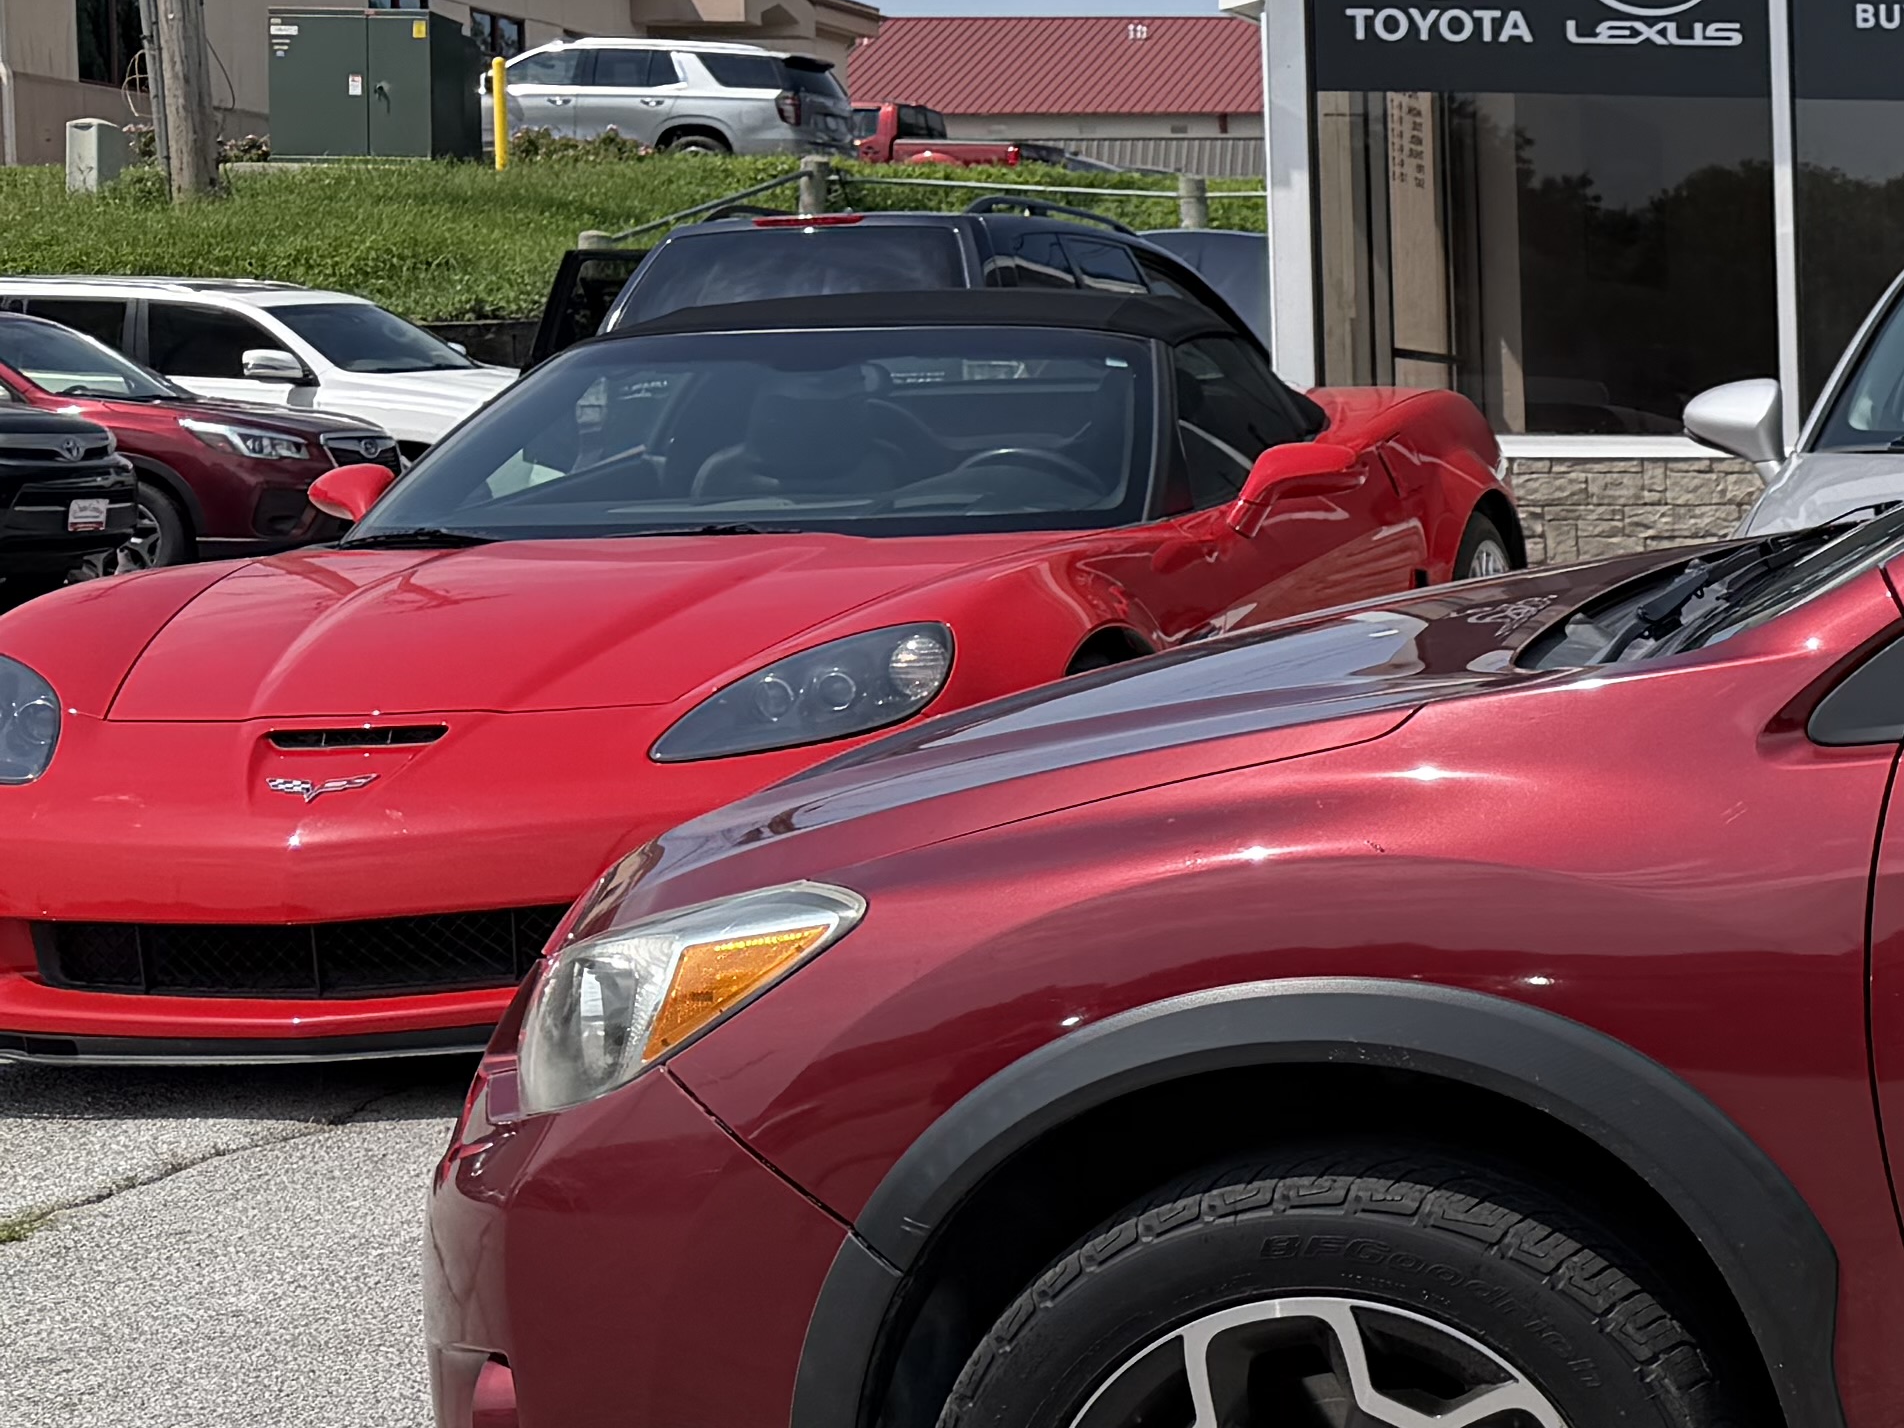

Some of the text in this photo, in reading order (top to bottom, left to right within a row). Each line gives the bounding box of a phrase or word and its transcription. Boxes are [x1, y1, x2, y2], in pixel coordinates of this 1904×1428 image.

[1345, 7, 1534, 43] TOYOTA
[1566, 19, 1743, 46] LEXUS
[1259, 1233, 1603, 1388] BFGoodrich
